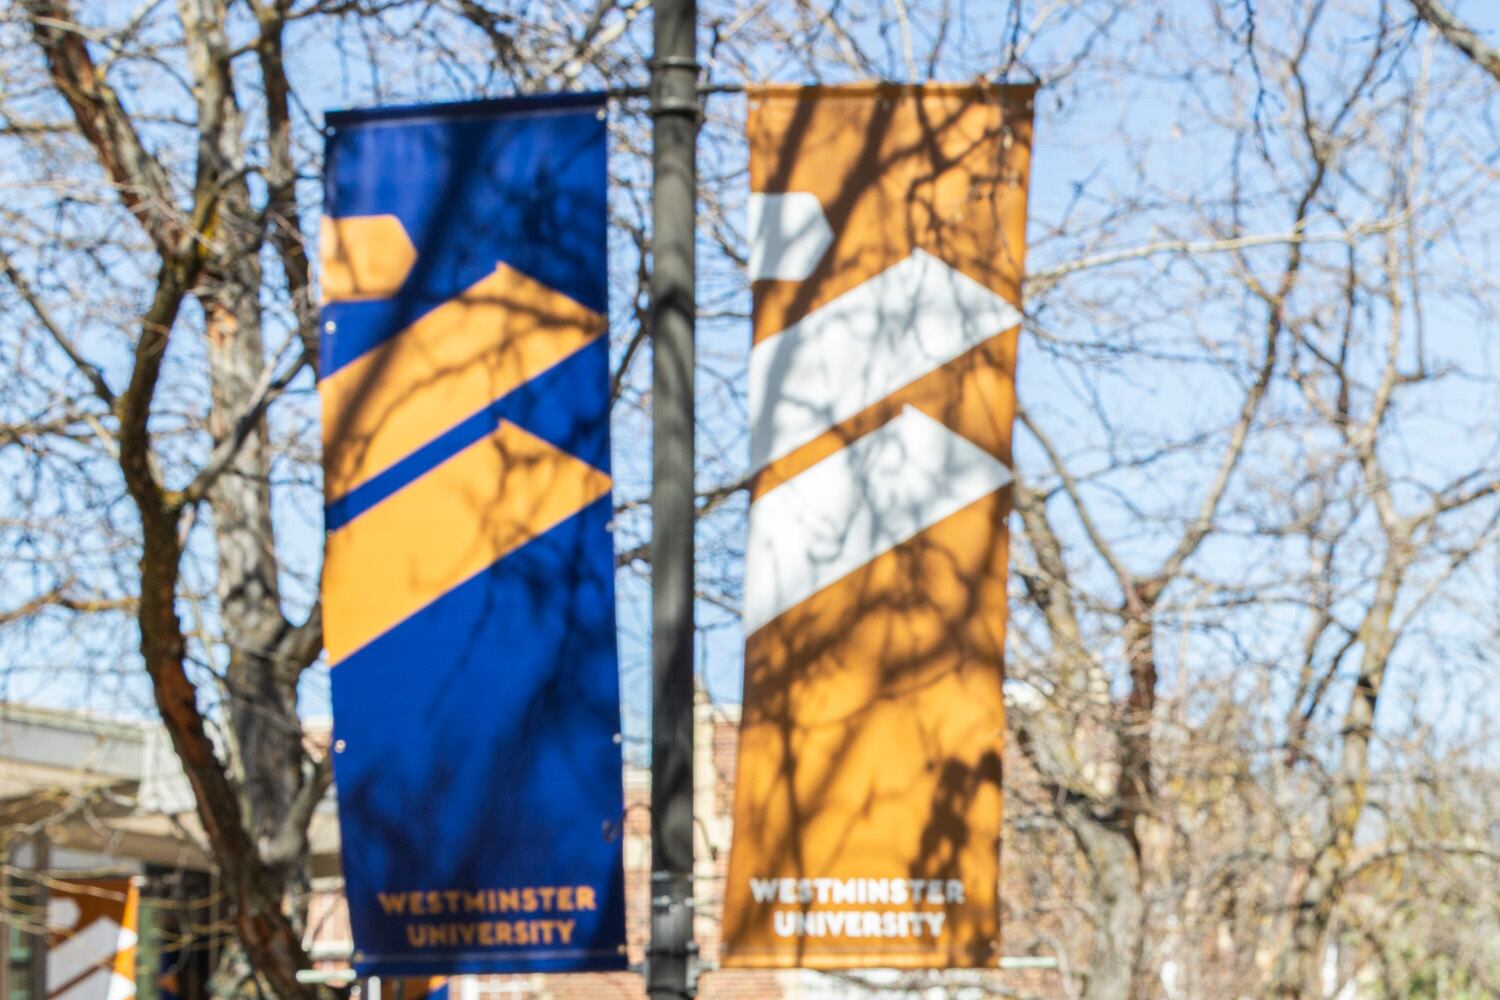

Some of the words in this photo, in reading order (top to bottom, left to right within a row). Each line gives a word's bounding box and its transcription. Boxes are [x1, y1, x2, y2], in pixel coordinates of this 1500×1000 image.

[377, 885, 597, 915] WESTMINSTER
[750, 877, 965, 904] WESTMINSTER
[405, 919, 576, 947] UNIVERSITY
[773, 911, 946, 937] UNIVERSITY
